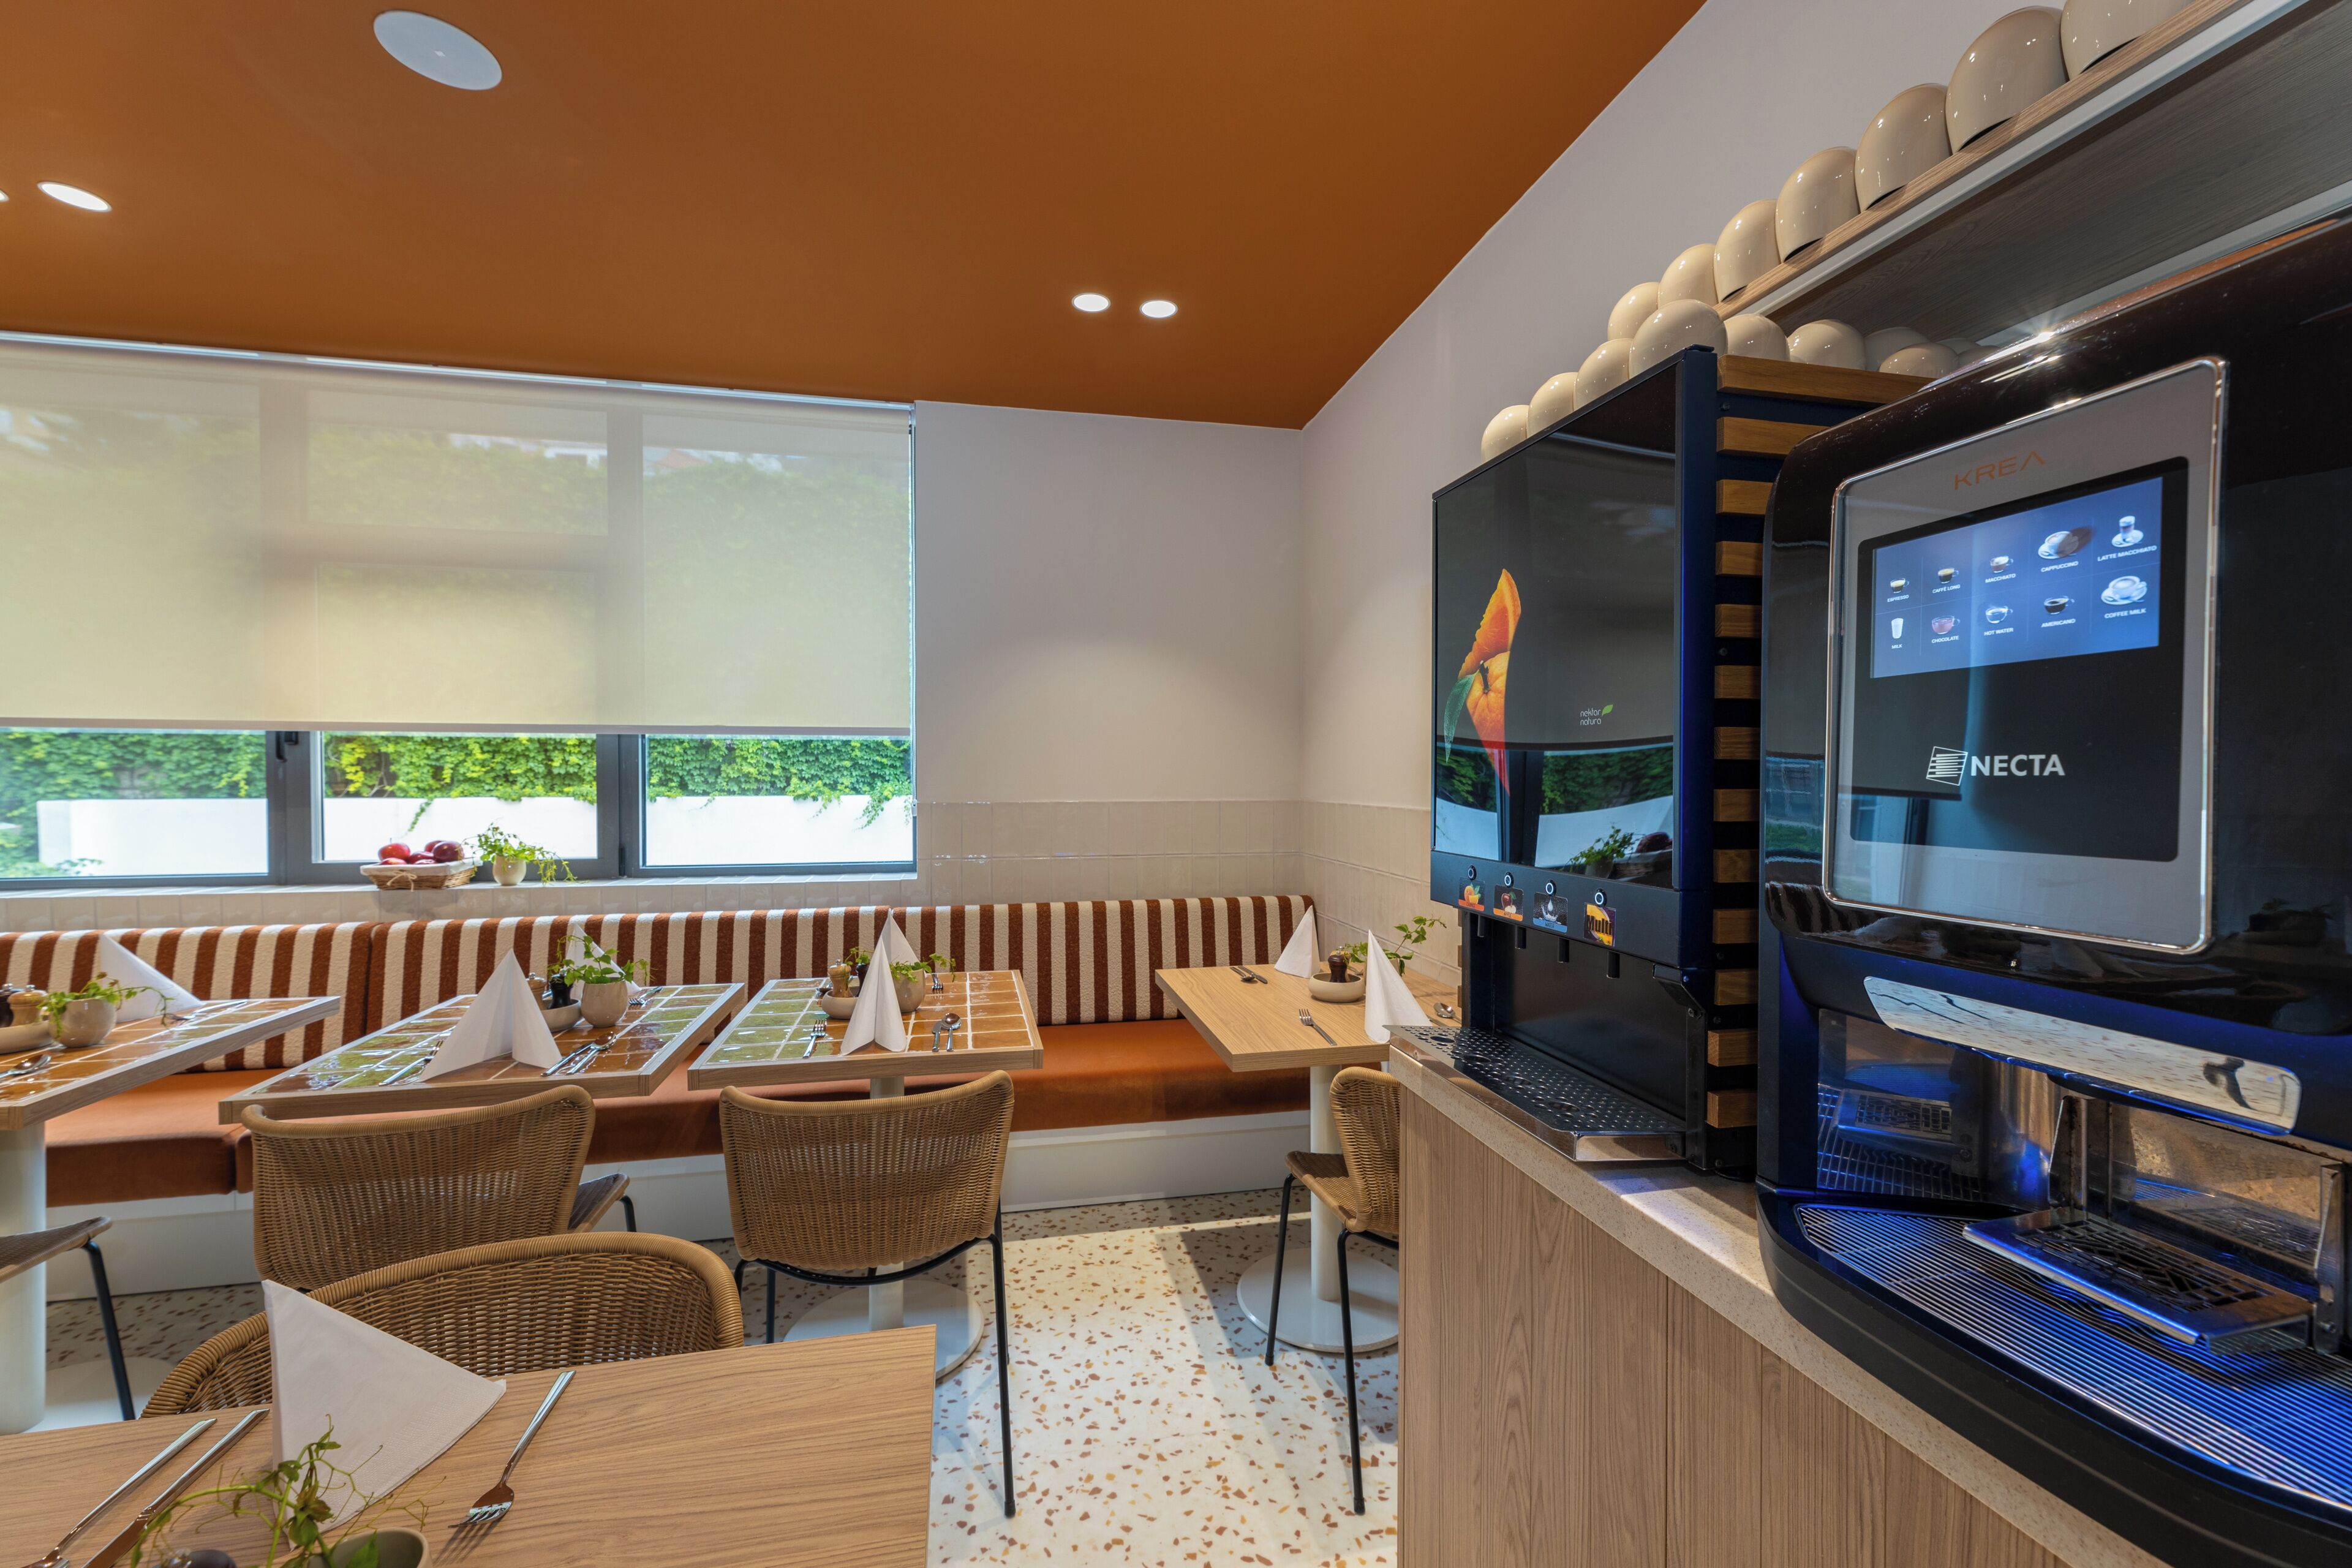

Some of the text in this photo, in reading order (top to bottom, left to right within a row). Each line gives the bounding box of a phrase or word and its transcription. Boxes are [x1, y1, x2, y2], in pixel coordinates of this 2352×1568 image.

[1954, 450, 2046, 491] KREA
[2097, 552, 2117, 562] LATTE
[2041, 561, 2079, 573] CAPPUCCINO
[1985, 573, 2016, 583] MACCHIATO
[1887, 594, 1909, 603] ESPRESSO
[2041, 618, 2076, 628] AMERICANO
[1931, 635, 1959, 644] CHOCOLATE
[1580, 707, 1602, 717] nektar
[1580, 717, 1602, 726] natura
[1970, 754, 2066, 777] NECTA
[1586, 914, 1612, 936] Multi
